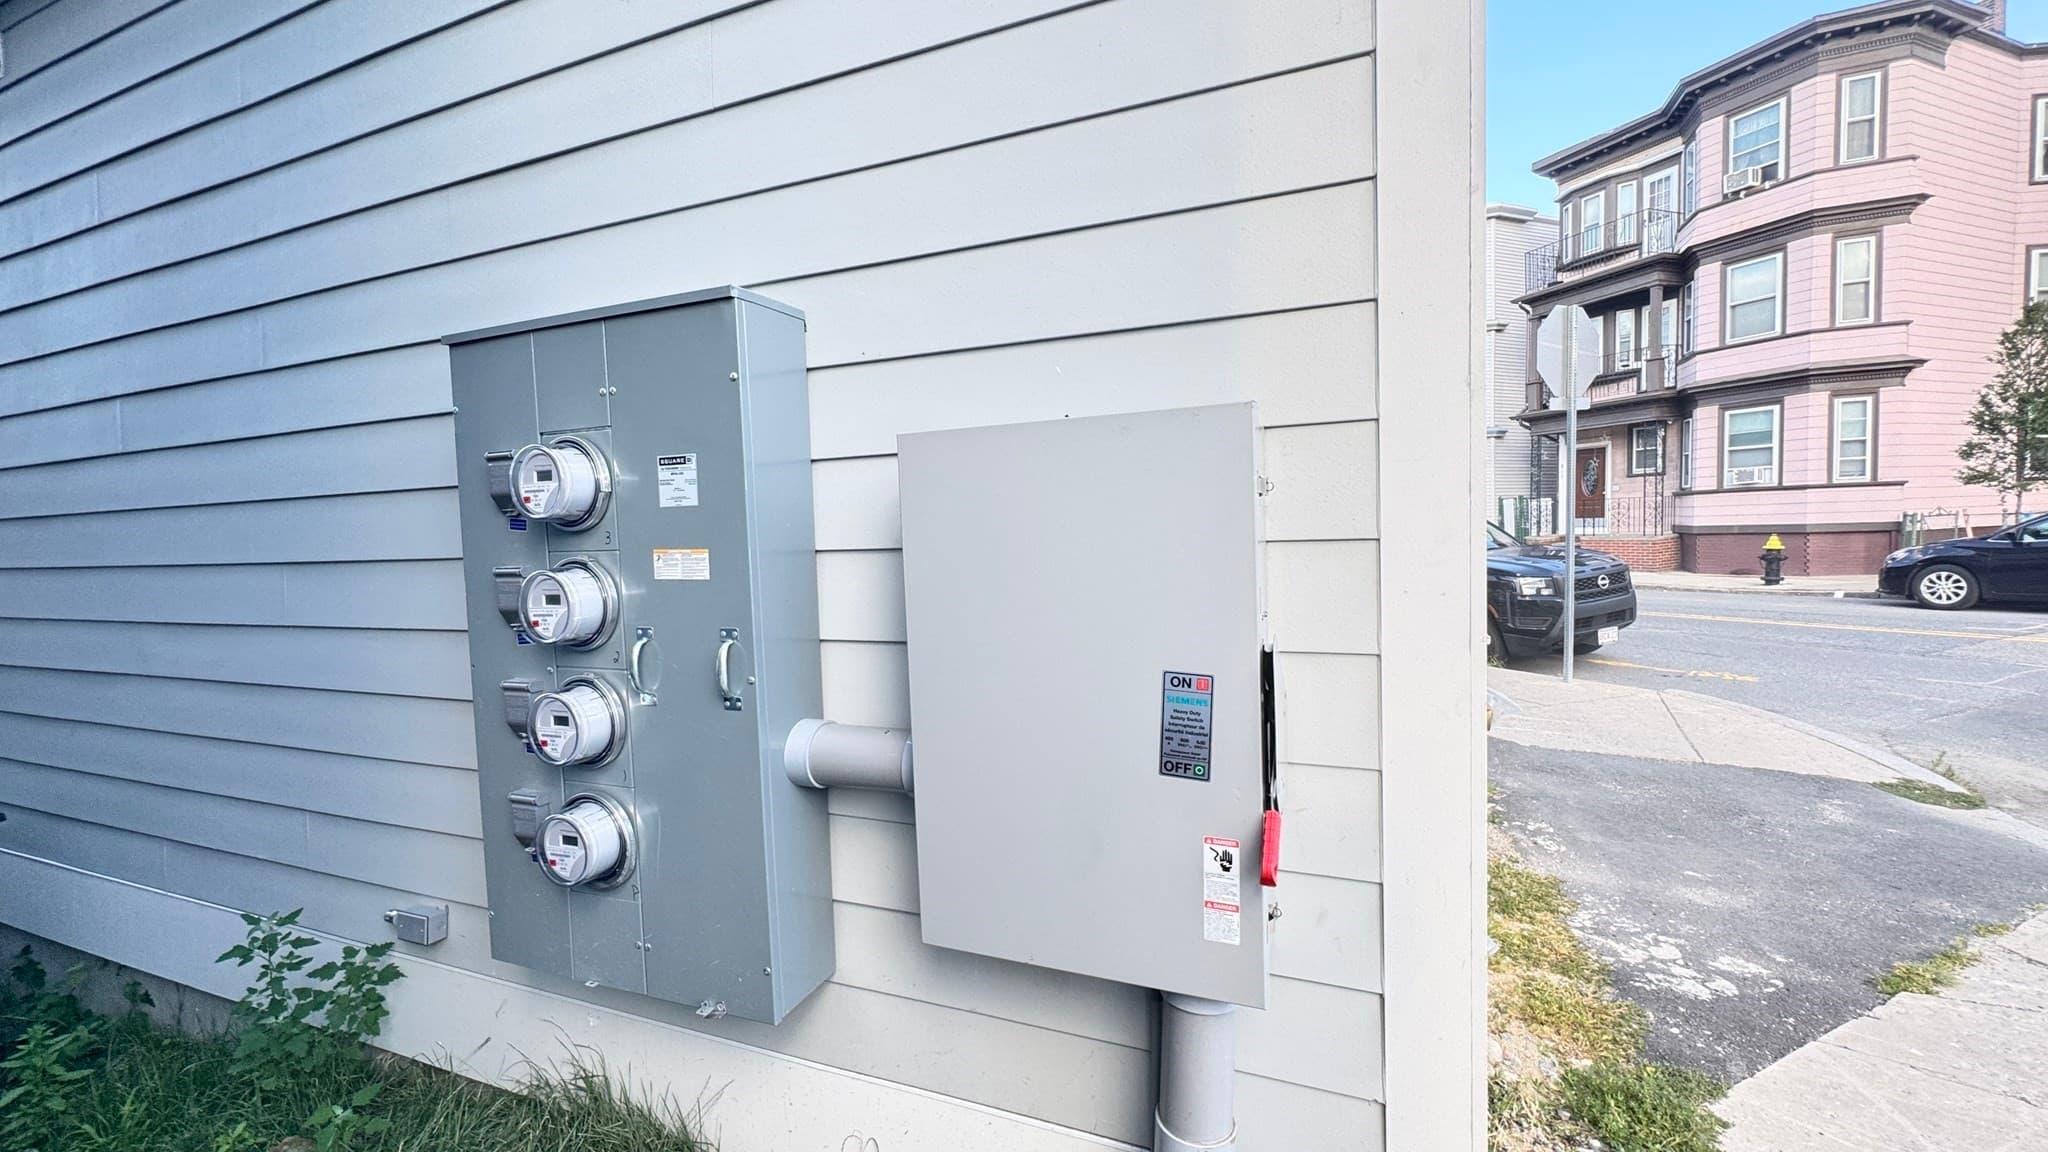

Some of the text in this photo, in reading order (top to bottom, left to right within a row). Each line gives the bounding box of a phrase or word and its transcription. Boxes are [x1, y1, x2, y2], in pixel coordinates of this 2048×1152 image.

[660, 457, 685, 465] SQUARE
[605, 530, 611, 545] 3
[1170, 676, 1192, 688] ON
[1167, 695, 1209, 707] SIEMENS
[1163, 760, 1193, 774] OFF
[1213, 838, 1237, 847] DANGER
[1213, 902, 1237, 911] DANGER
